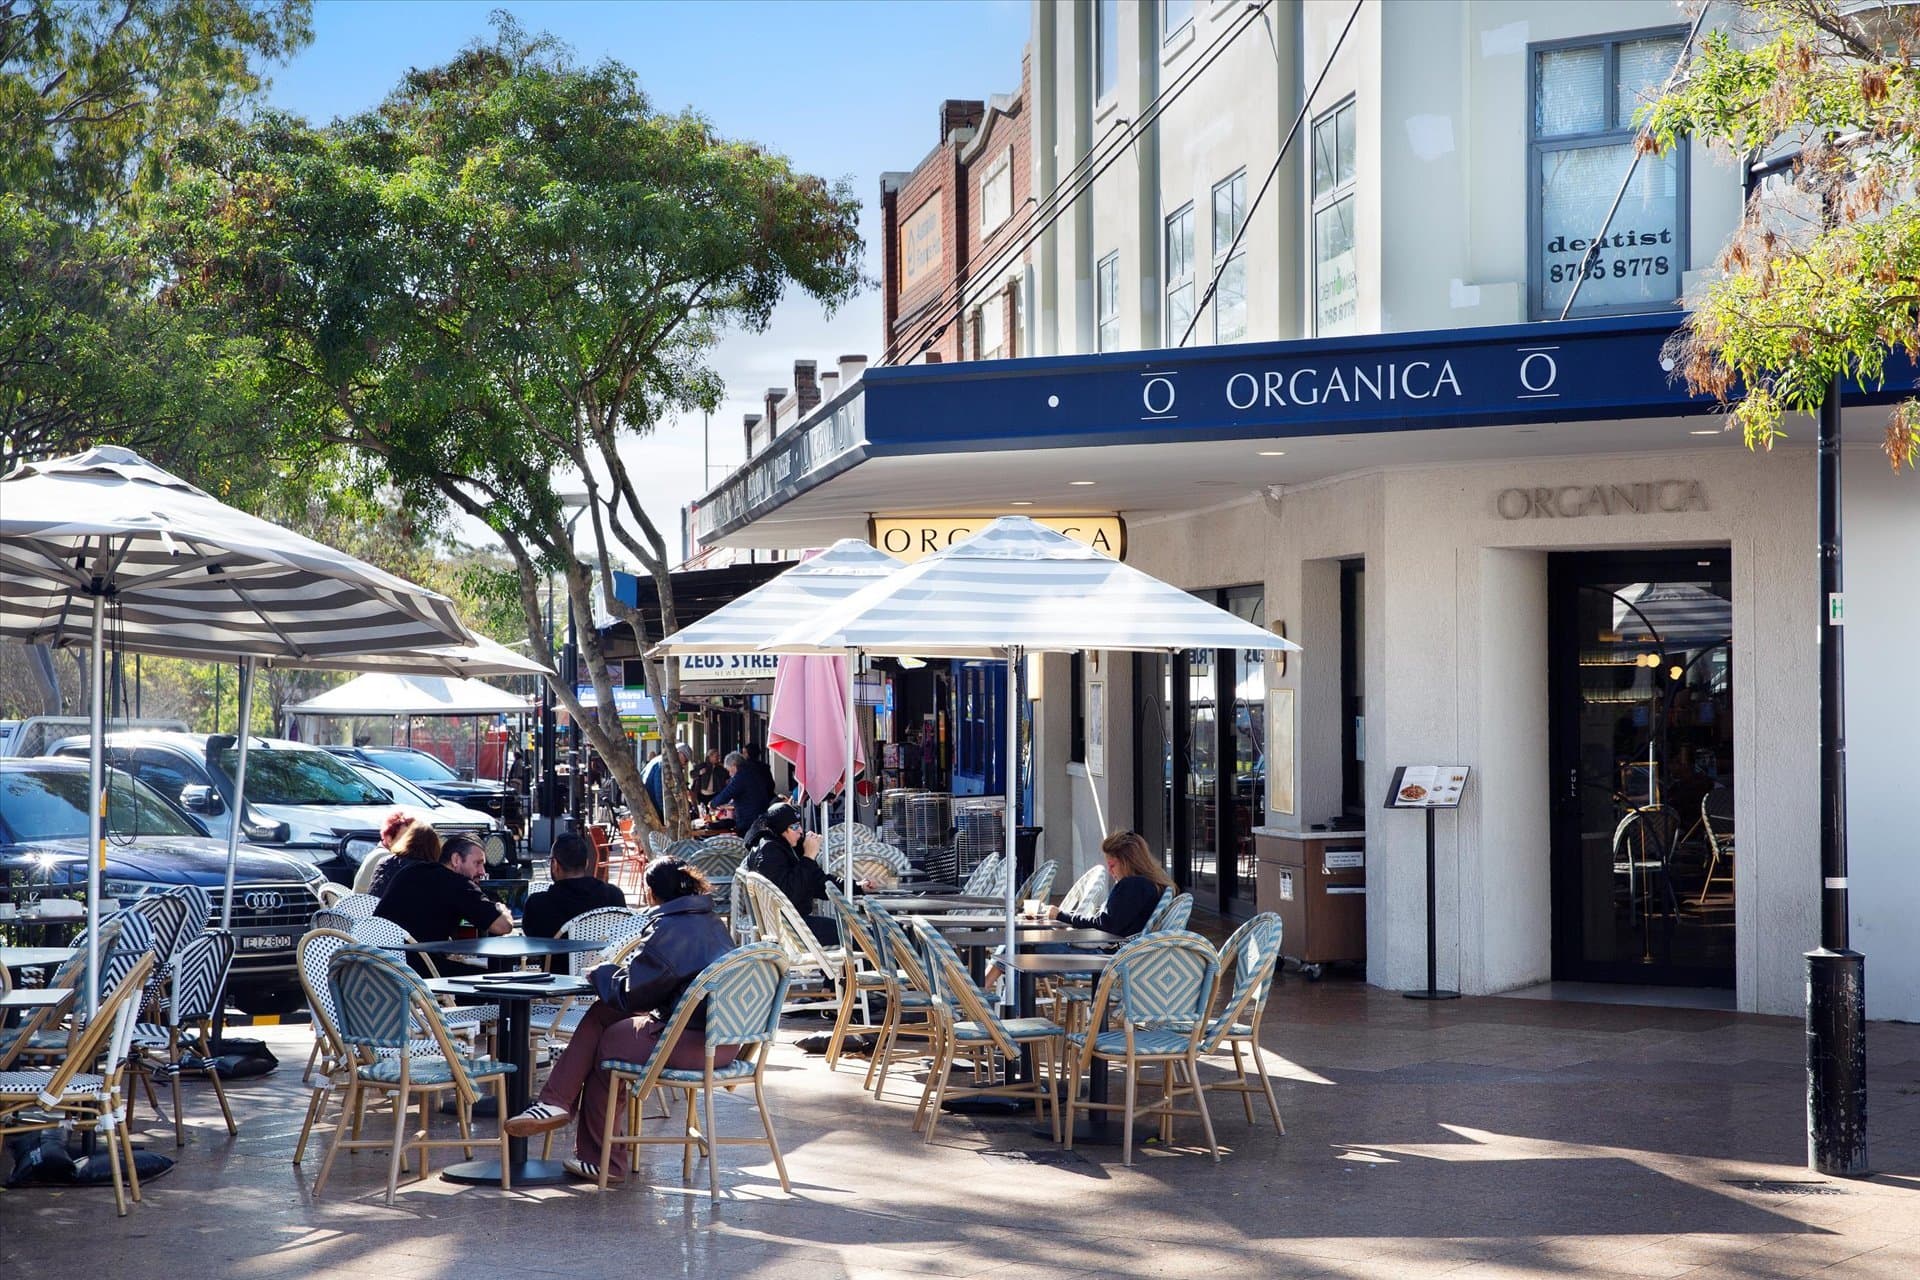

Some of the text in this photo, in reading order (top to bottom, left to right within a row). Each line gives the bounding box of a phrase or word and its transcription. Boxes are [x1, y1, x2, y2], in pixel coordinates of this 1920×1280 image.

[1547, 227, 1672, 253] dentist
[1613, 256, 1669, 278] 8778
[1226, 359, 1463, 411] ORGANICA
[1496, 479, 1710, 520] ORGANICA
[1832, 598, 1844, 619] H
[684, 655, 724, 669] ZEUS
